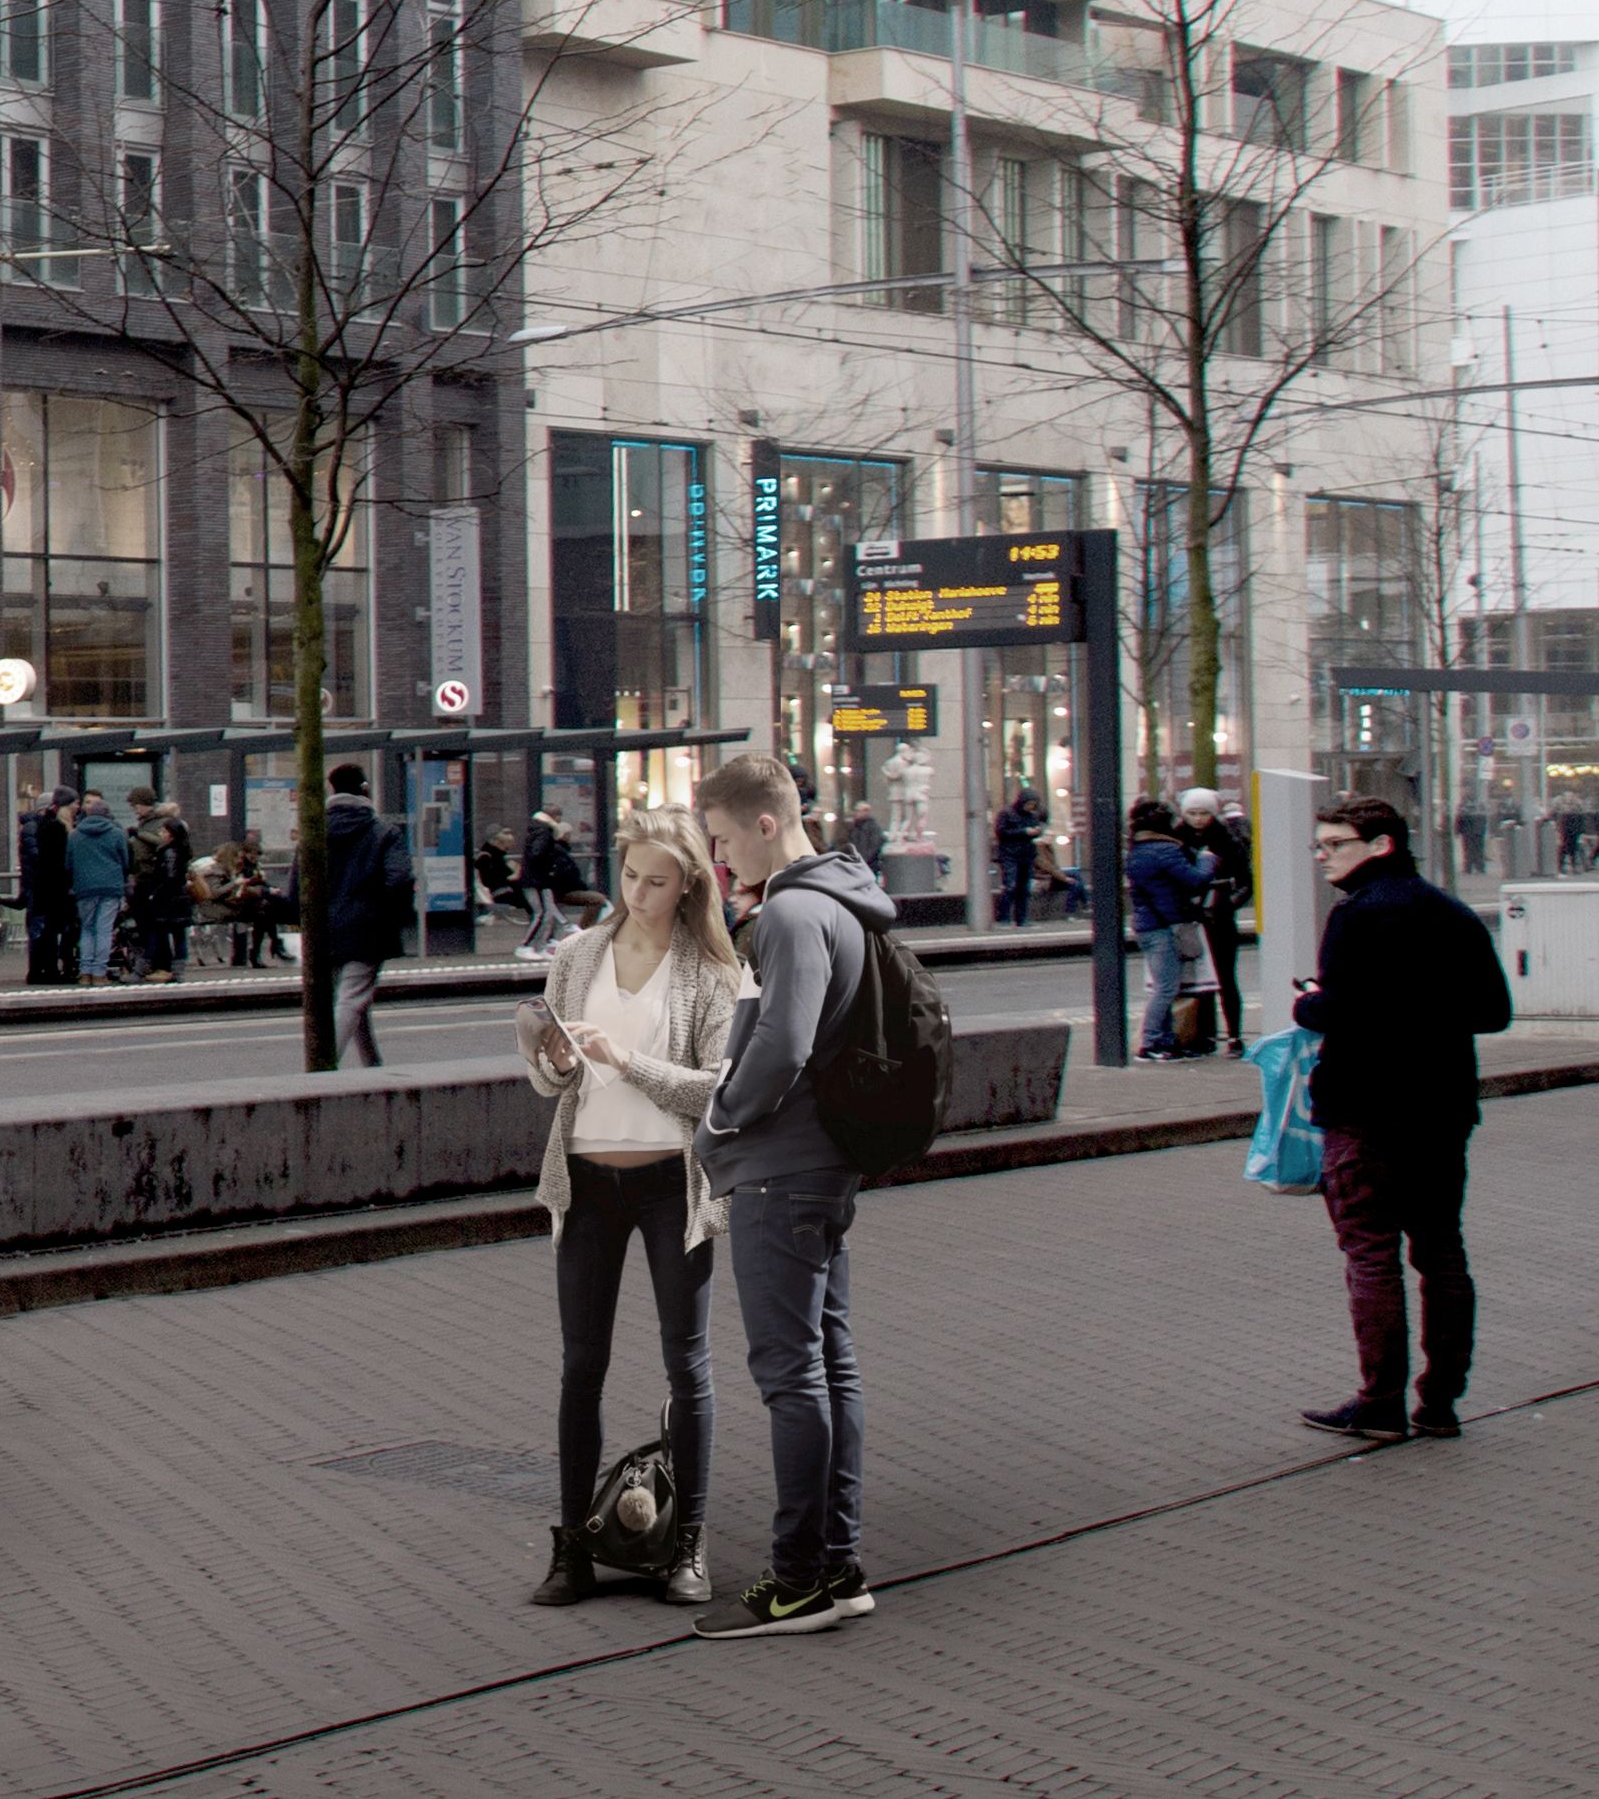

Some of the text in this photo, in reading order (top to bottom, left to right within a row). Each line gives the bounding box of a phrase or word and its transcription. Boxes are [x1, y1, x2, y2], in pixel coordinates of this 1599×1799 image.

[446, 517, 463, 560] VAN
[755, 477, 779, 600] PRIMARK
[856, 564, 923, 577] Centrum
